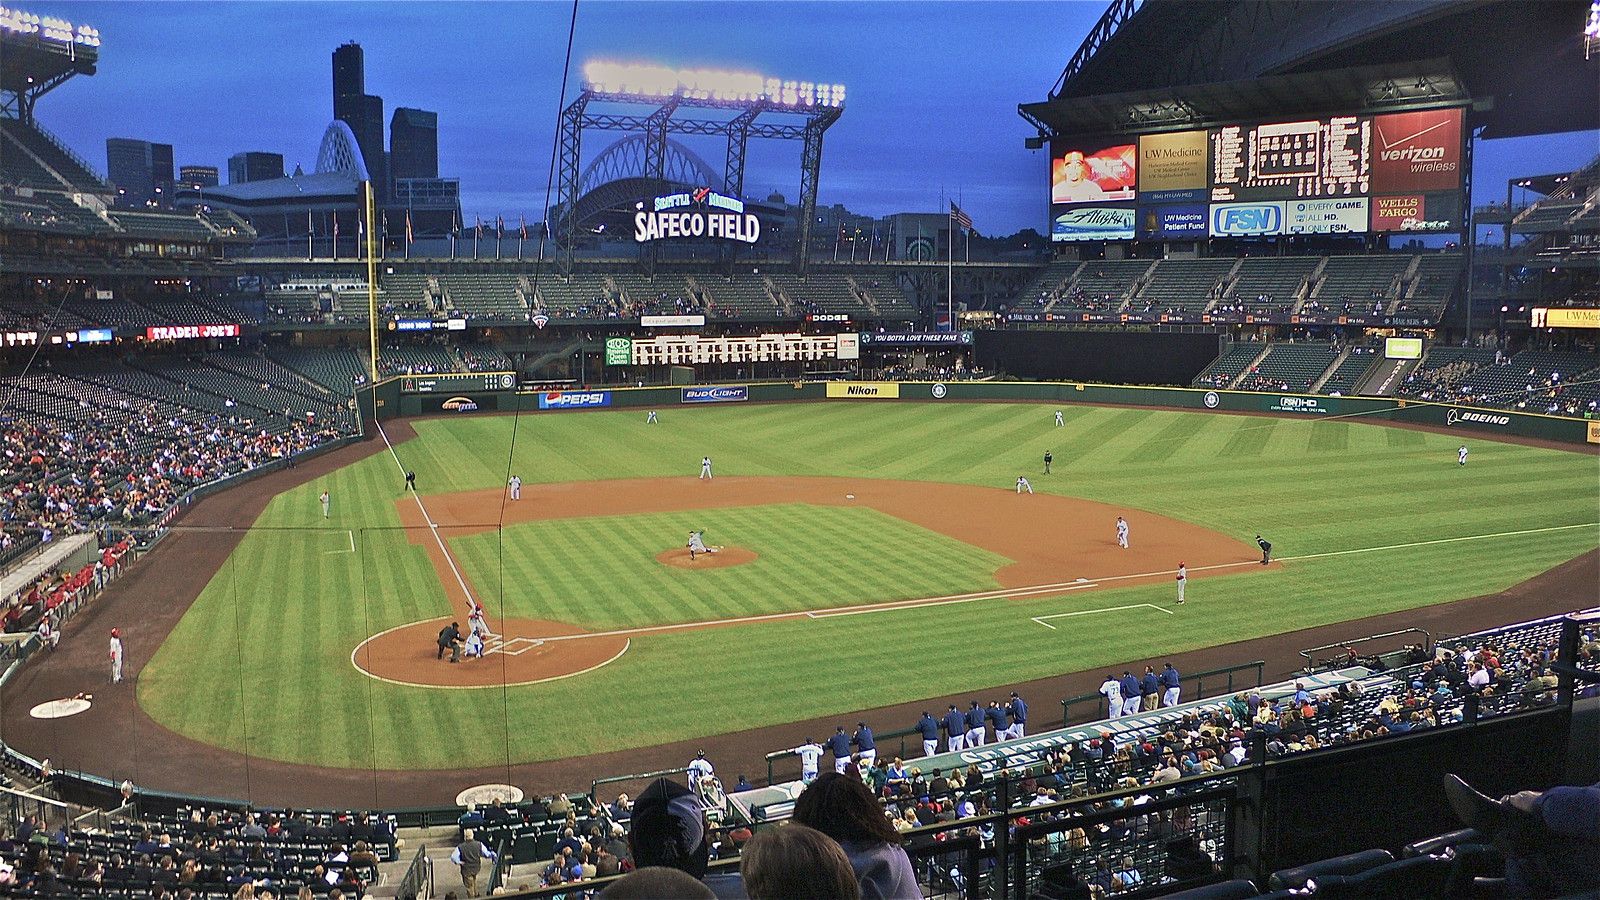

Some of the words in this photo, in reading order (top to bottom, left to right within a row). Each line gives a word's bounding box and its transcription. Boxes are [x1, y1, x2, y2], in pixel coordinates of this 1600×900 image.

[1145, 149, 1162, 159] UW
[1163, 147, 1203, 158] Medicine
[1380, 146, 1444, 162] verizon
[1410, 161, 1456, 172] wireless
[1343, 183, 1351, 194] 2
[1379, 198, 1418, 208] WELLS
[1379, 208, 1417, 217] FARGO
[1224, 209, 1270, 230] FSN
[634, 211, 704, 242] SAFECO
[708, 213, 760, 243] FIELD
[152, 327, 199, 340] TRADER
[203, 325, 235, 337] JOE'S
[848, 386, 878, 395] Nikon
[561, 393, 603, 405] PEPSI
[1461, 412, 1510, 425] BOEING
